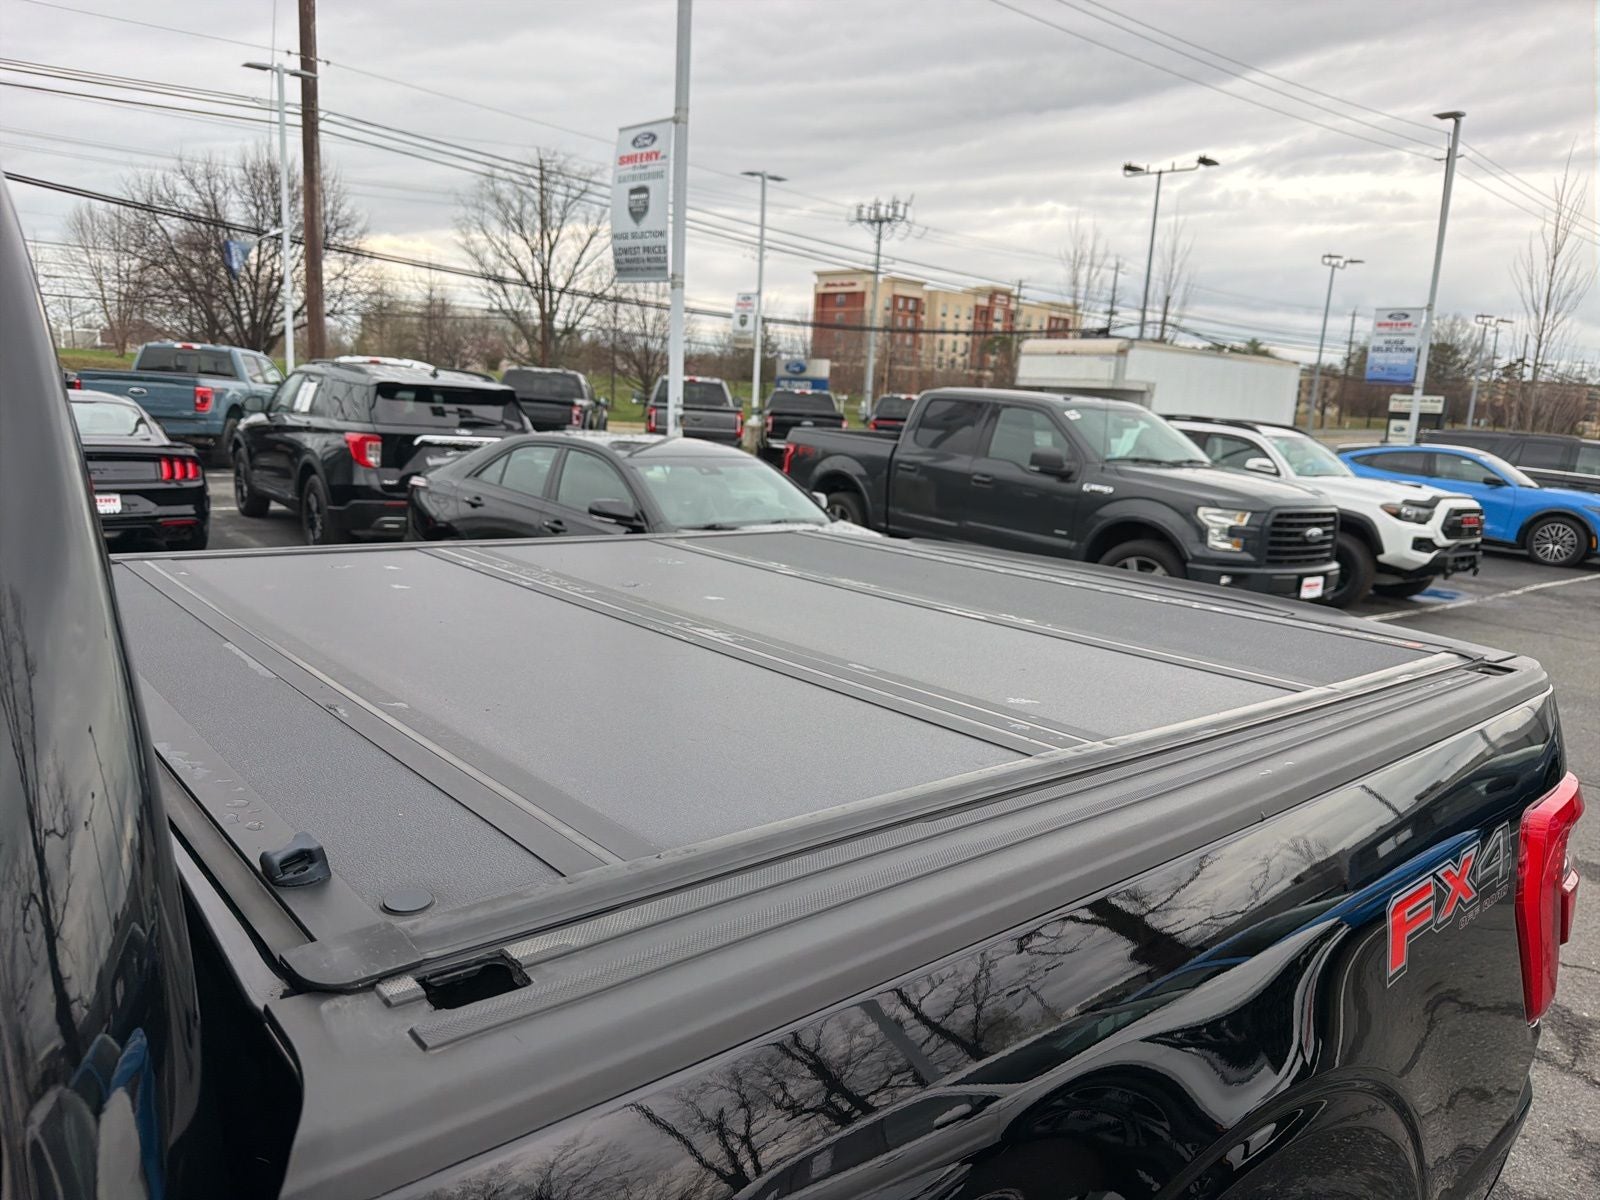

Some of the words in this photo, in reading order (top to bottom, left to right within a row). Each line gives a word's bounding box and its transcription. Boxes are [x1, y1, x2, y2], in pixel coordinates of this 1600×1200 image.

[618, 150, 661, 166] SHEEHY
[613, 246, 641, 257] LOWEST
[642, 244, 667, 255] PRICES
[1386, 819, 1513, 988] FX4
